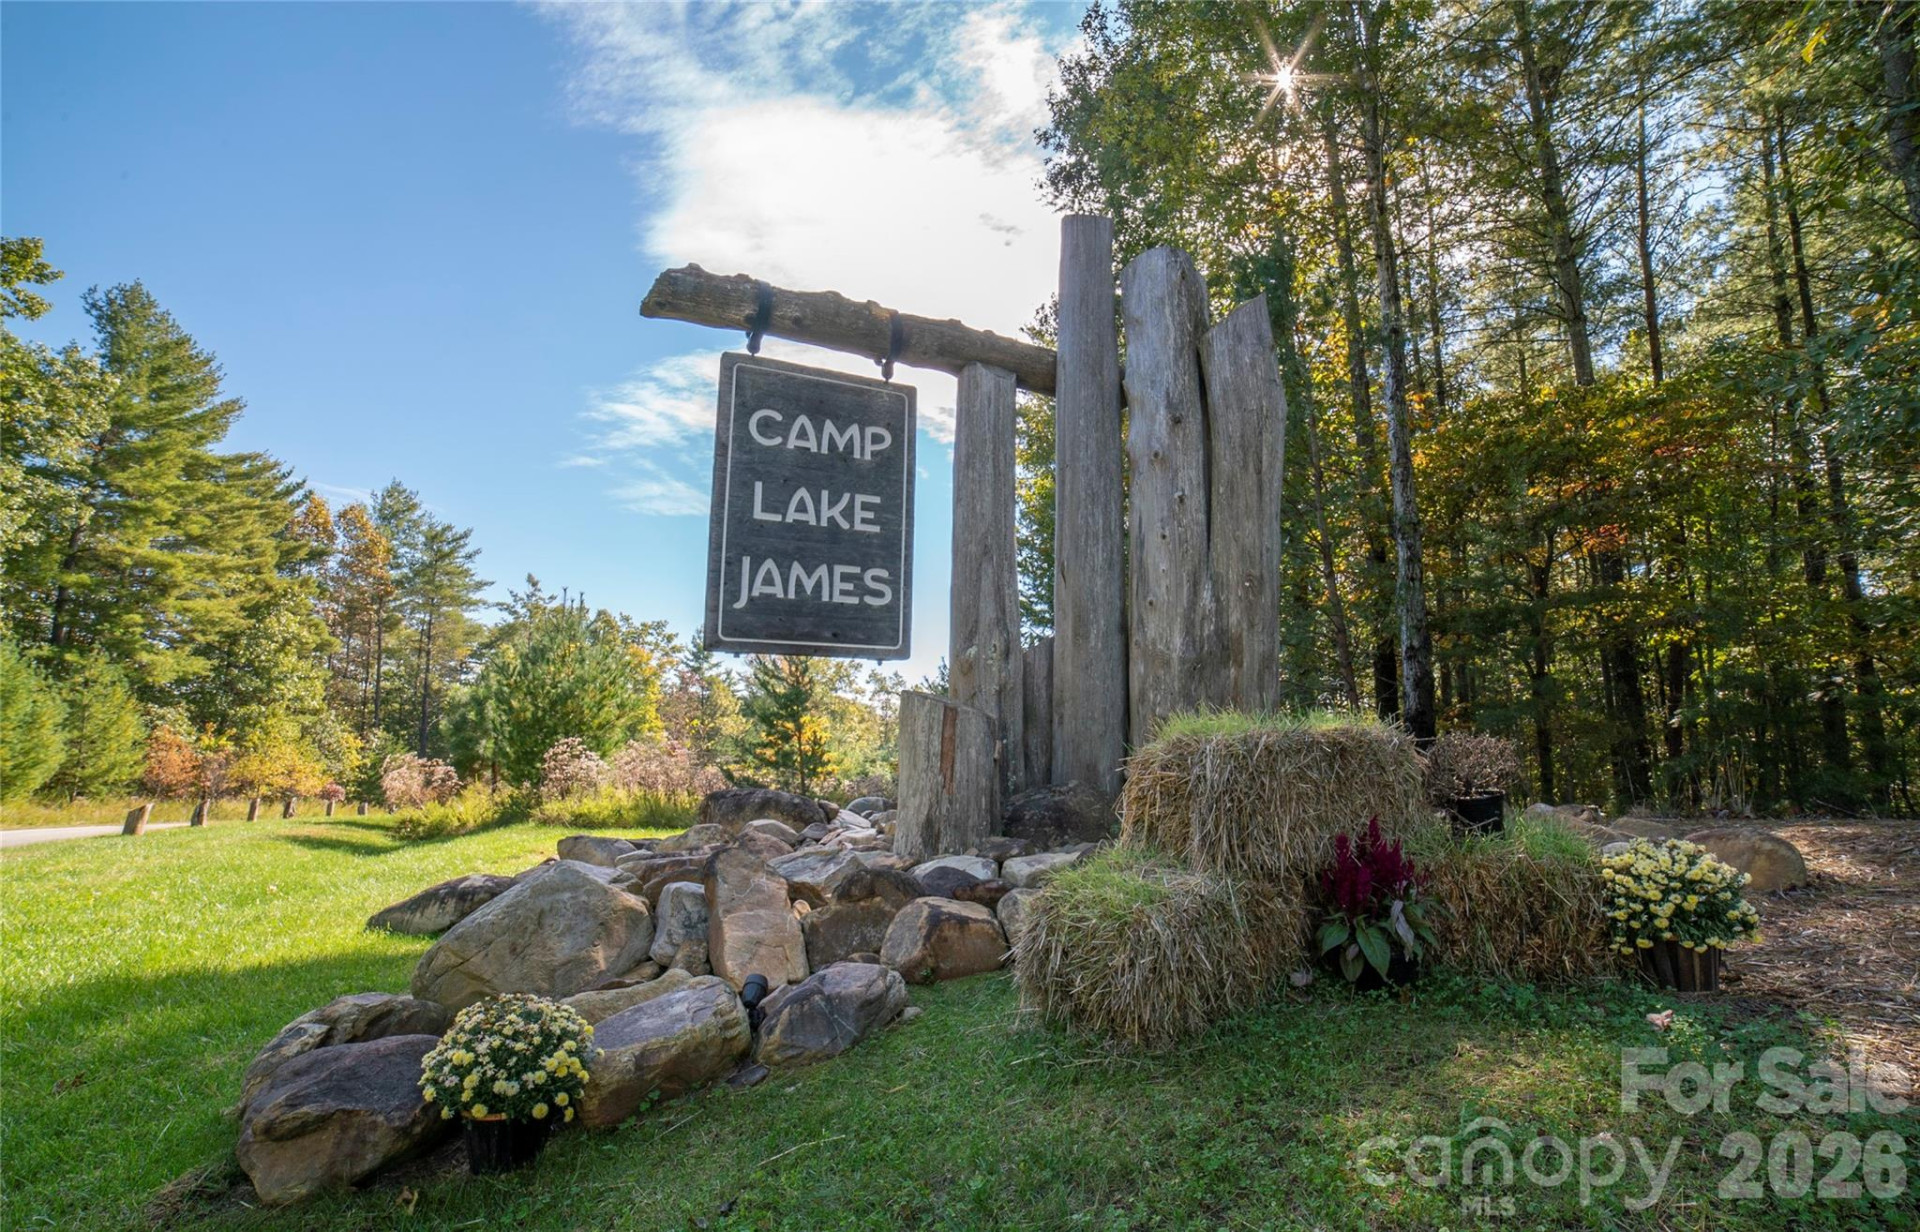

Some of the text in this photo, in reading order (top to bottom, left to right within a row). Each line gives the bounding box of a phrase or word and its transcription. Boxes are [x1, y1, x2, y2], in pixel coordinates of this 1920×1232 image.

[748, 408, 892, 461] CAMP
[753, 480, 881, 533] LAKE
[732, 555, 893, 609] JAMES
